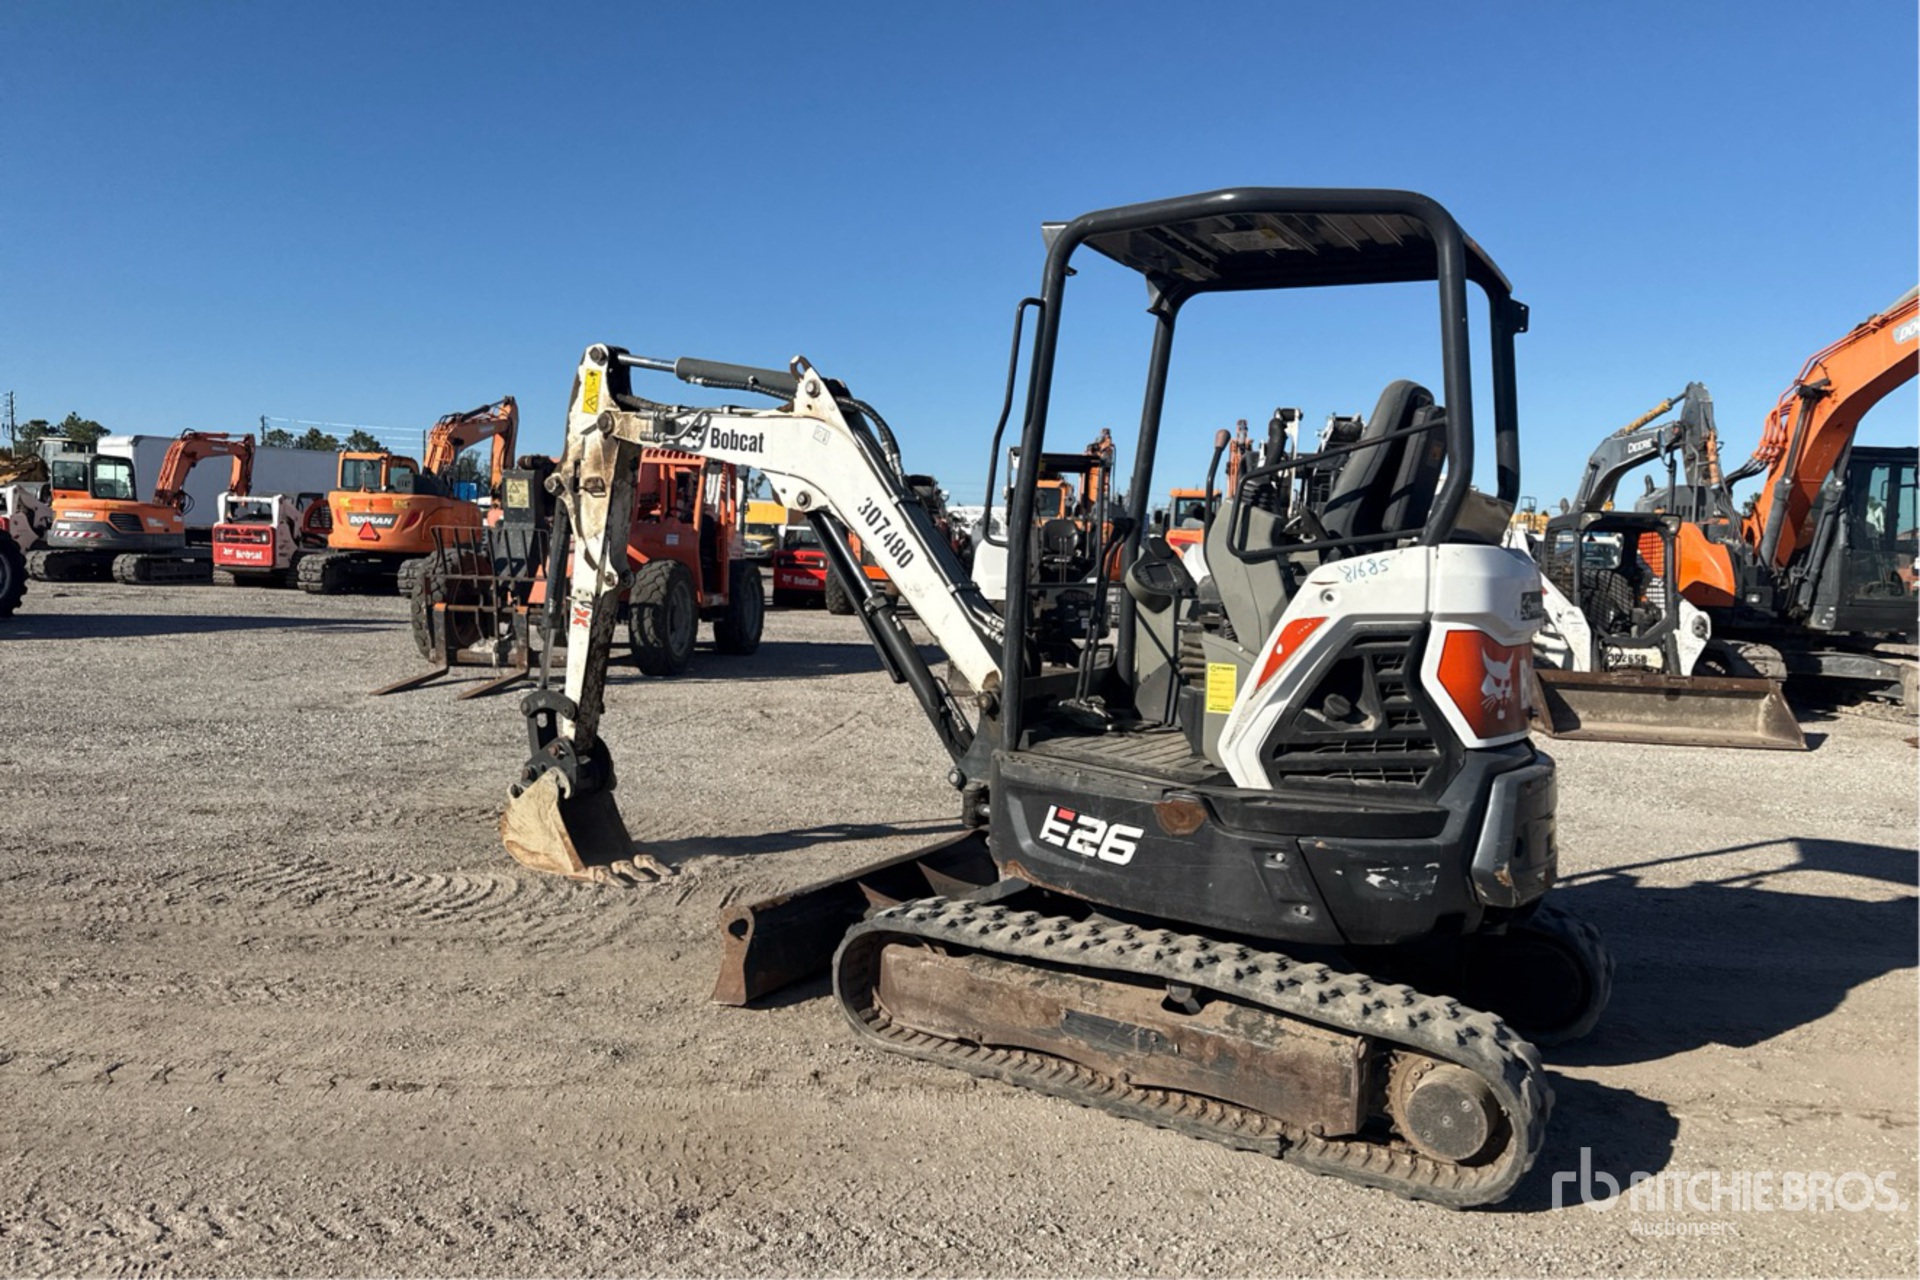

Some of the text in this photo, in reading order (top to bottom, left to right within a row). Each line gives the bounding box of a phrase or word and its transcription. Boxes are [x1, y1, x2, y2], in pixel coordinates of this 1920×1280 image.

[710, 427, 764, 453] Bobcat
[1628, 437, 1653, 454] DEERE
[350, 515, 393, 525] DOOSAN
[857, 496, 914, 569] 307480
[1338, 558, 1390, 583] 81685
[1039, 804, 1145, 866] E26
